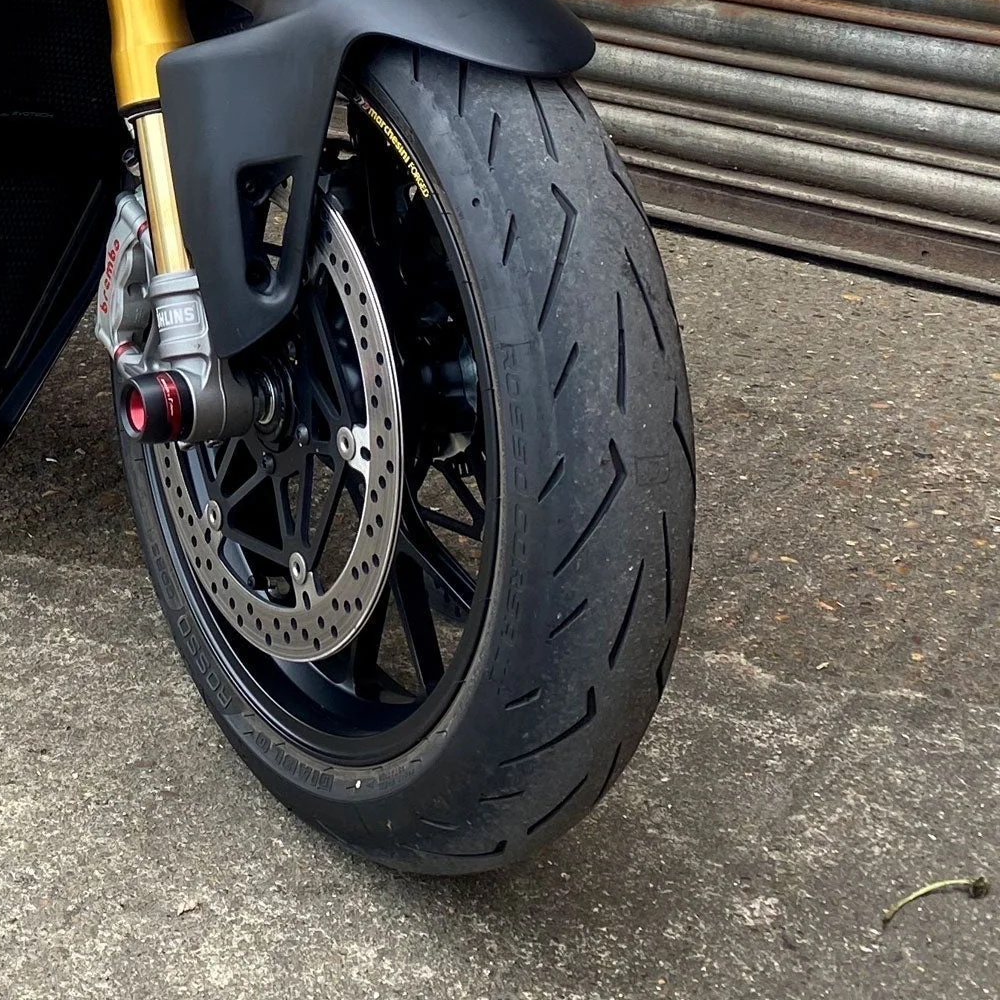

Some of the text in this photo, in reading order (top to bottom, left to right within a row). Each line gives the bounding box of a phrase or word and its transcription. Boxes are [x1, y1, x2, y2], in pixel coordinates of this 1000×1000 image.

[368, 107, 430, 198] marchesini FORGED
[99, 239, 120, 315] brembo
[157, 306, 195, 329] HLINS
[175, 613, 232, 711] ROSSO
[256, 732, 336, 794] DIABLO
